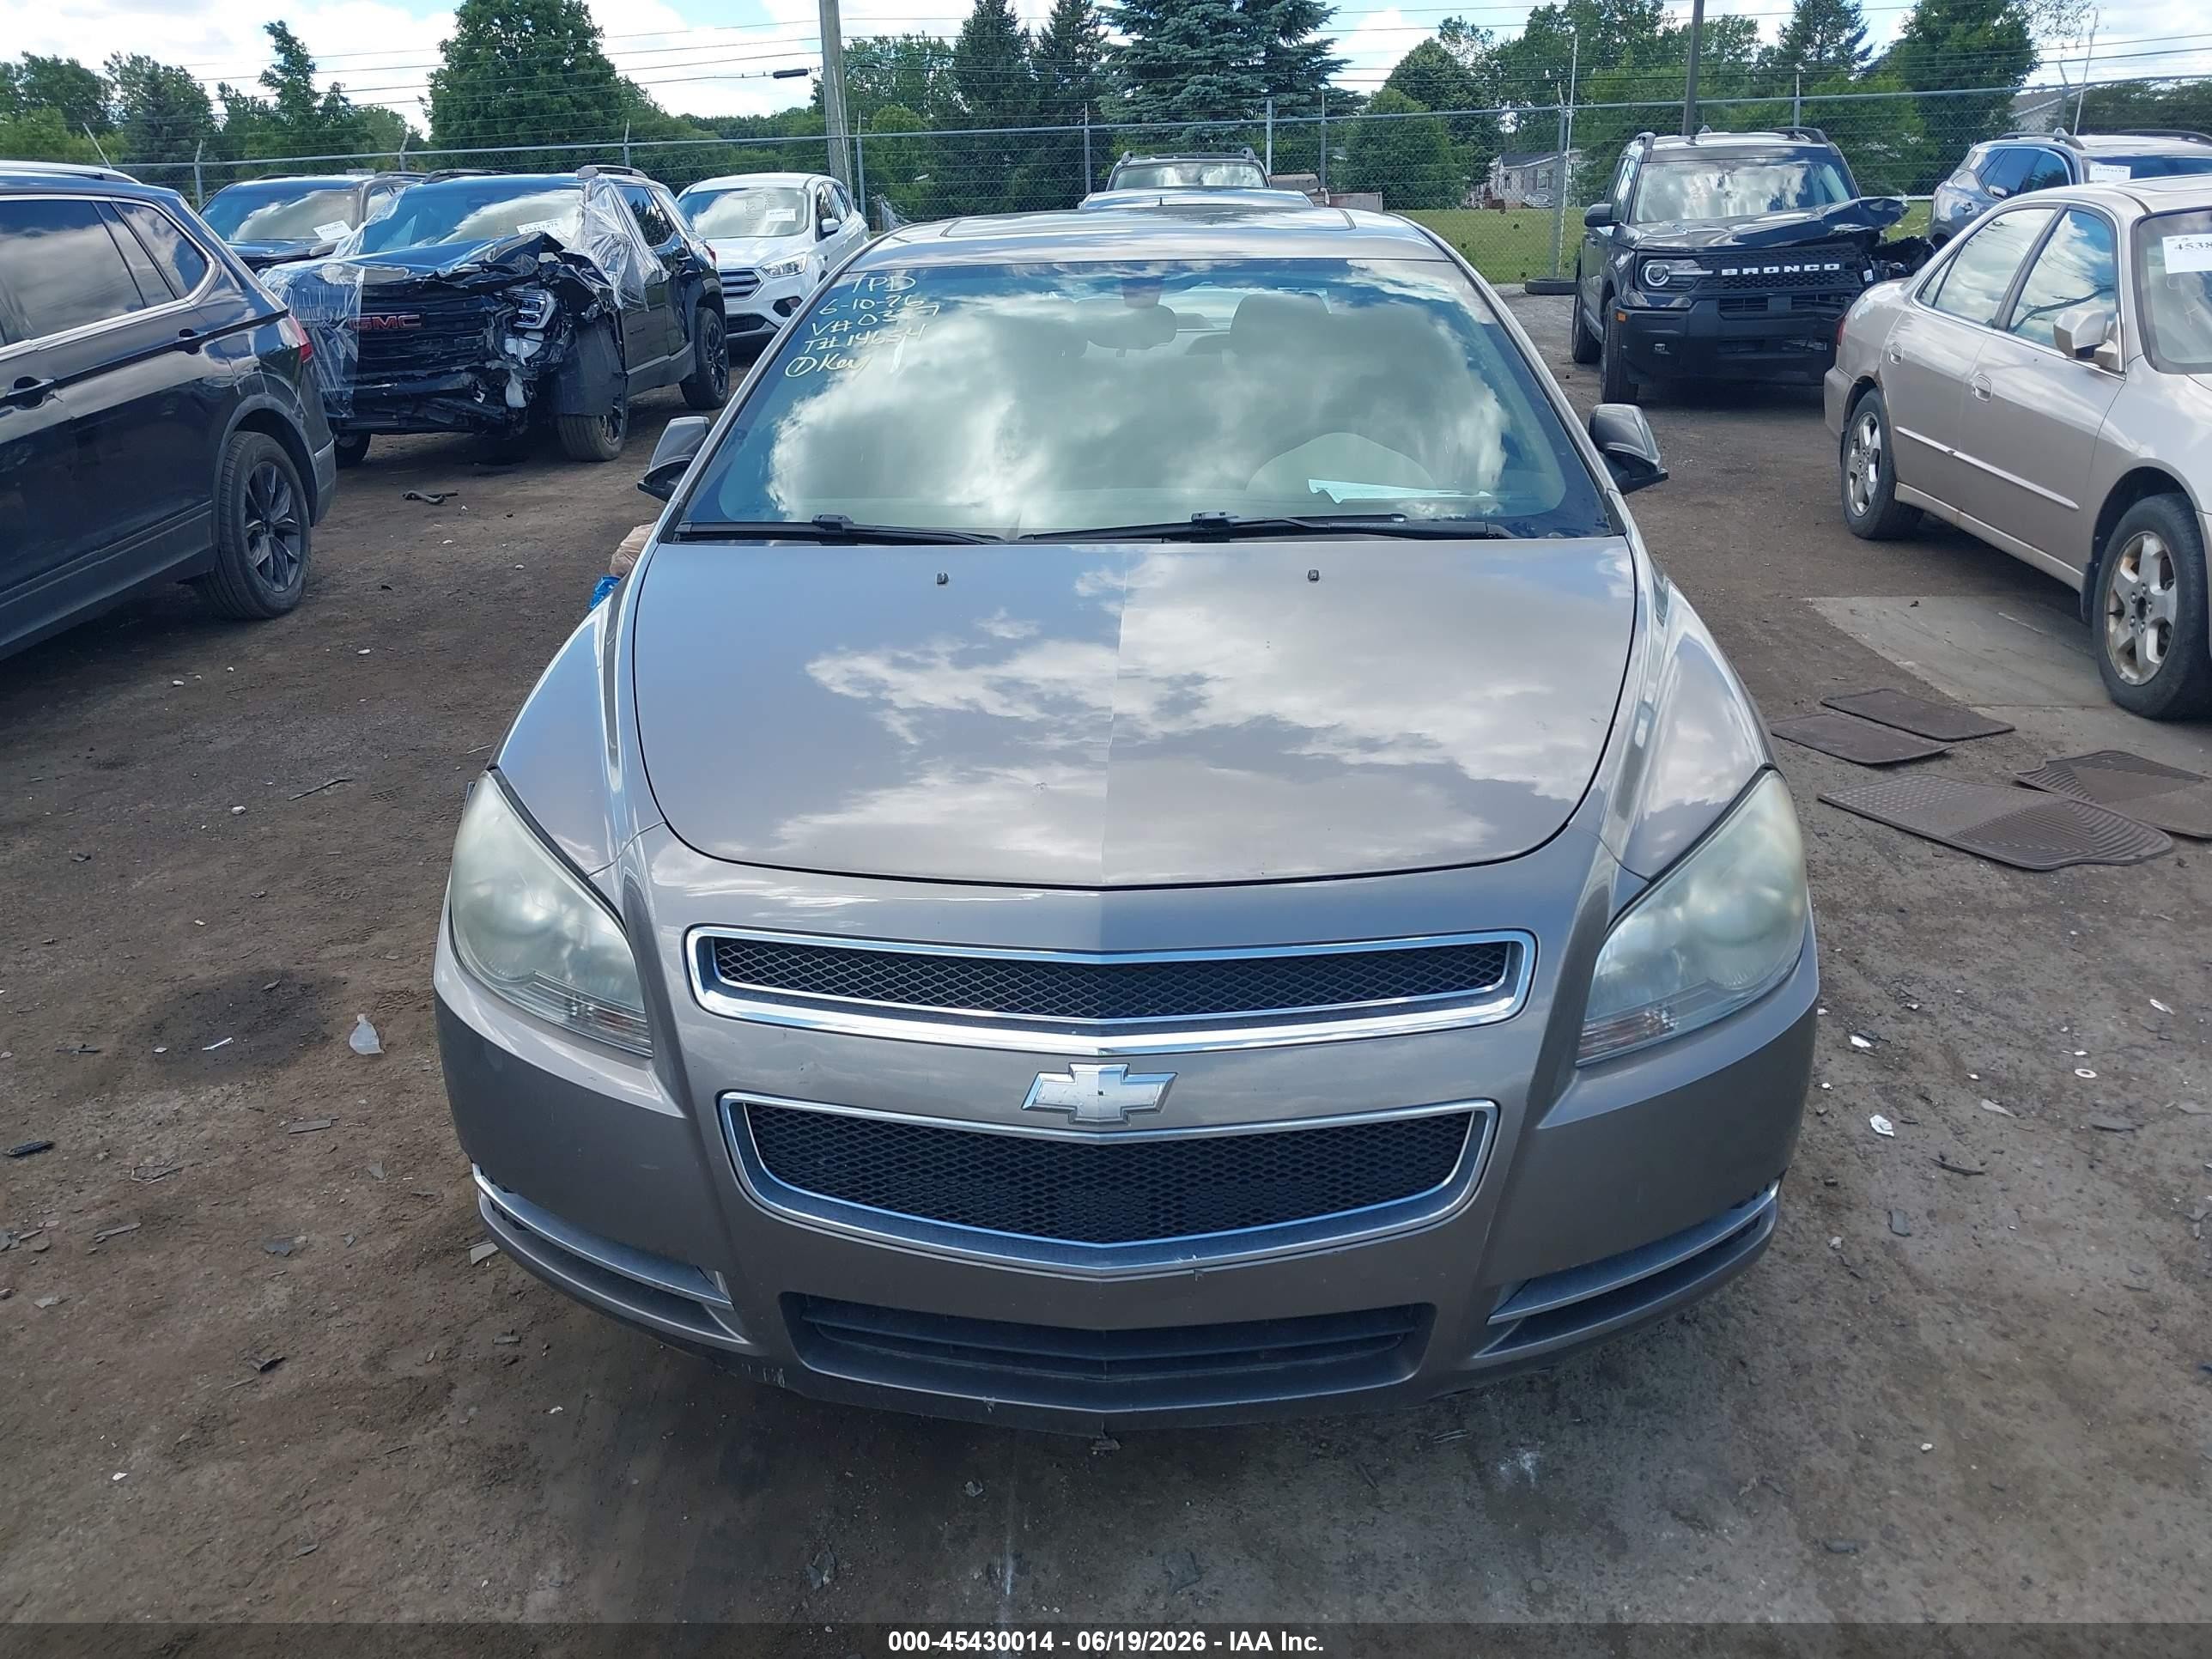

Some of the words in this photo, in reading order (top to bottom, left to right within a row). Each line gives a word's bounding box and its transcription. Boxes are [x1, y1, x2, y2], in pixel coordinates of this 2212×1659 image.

[1722, 264, 1840, 276] BRONCO
[852, 272, 916, 293] TPD
[349, 314, 421, 330] GMC
